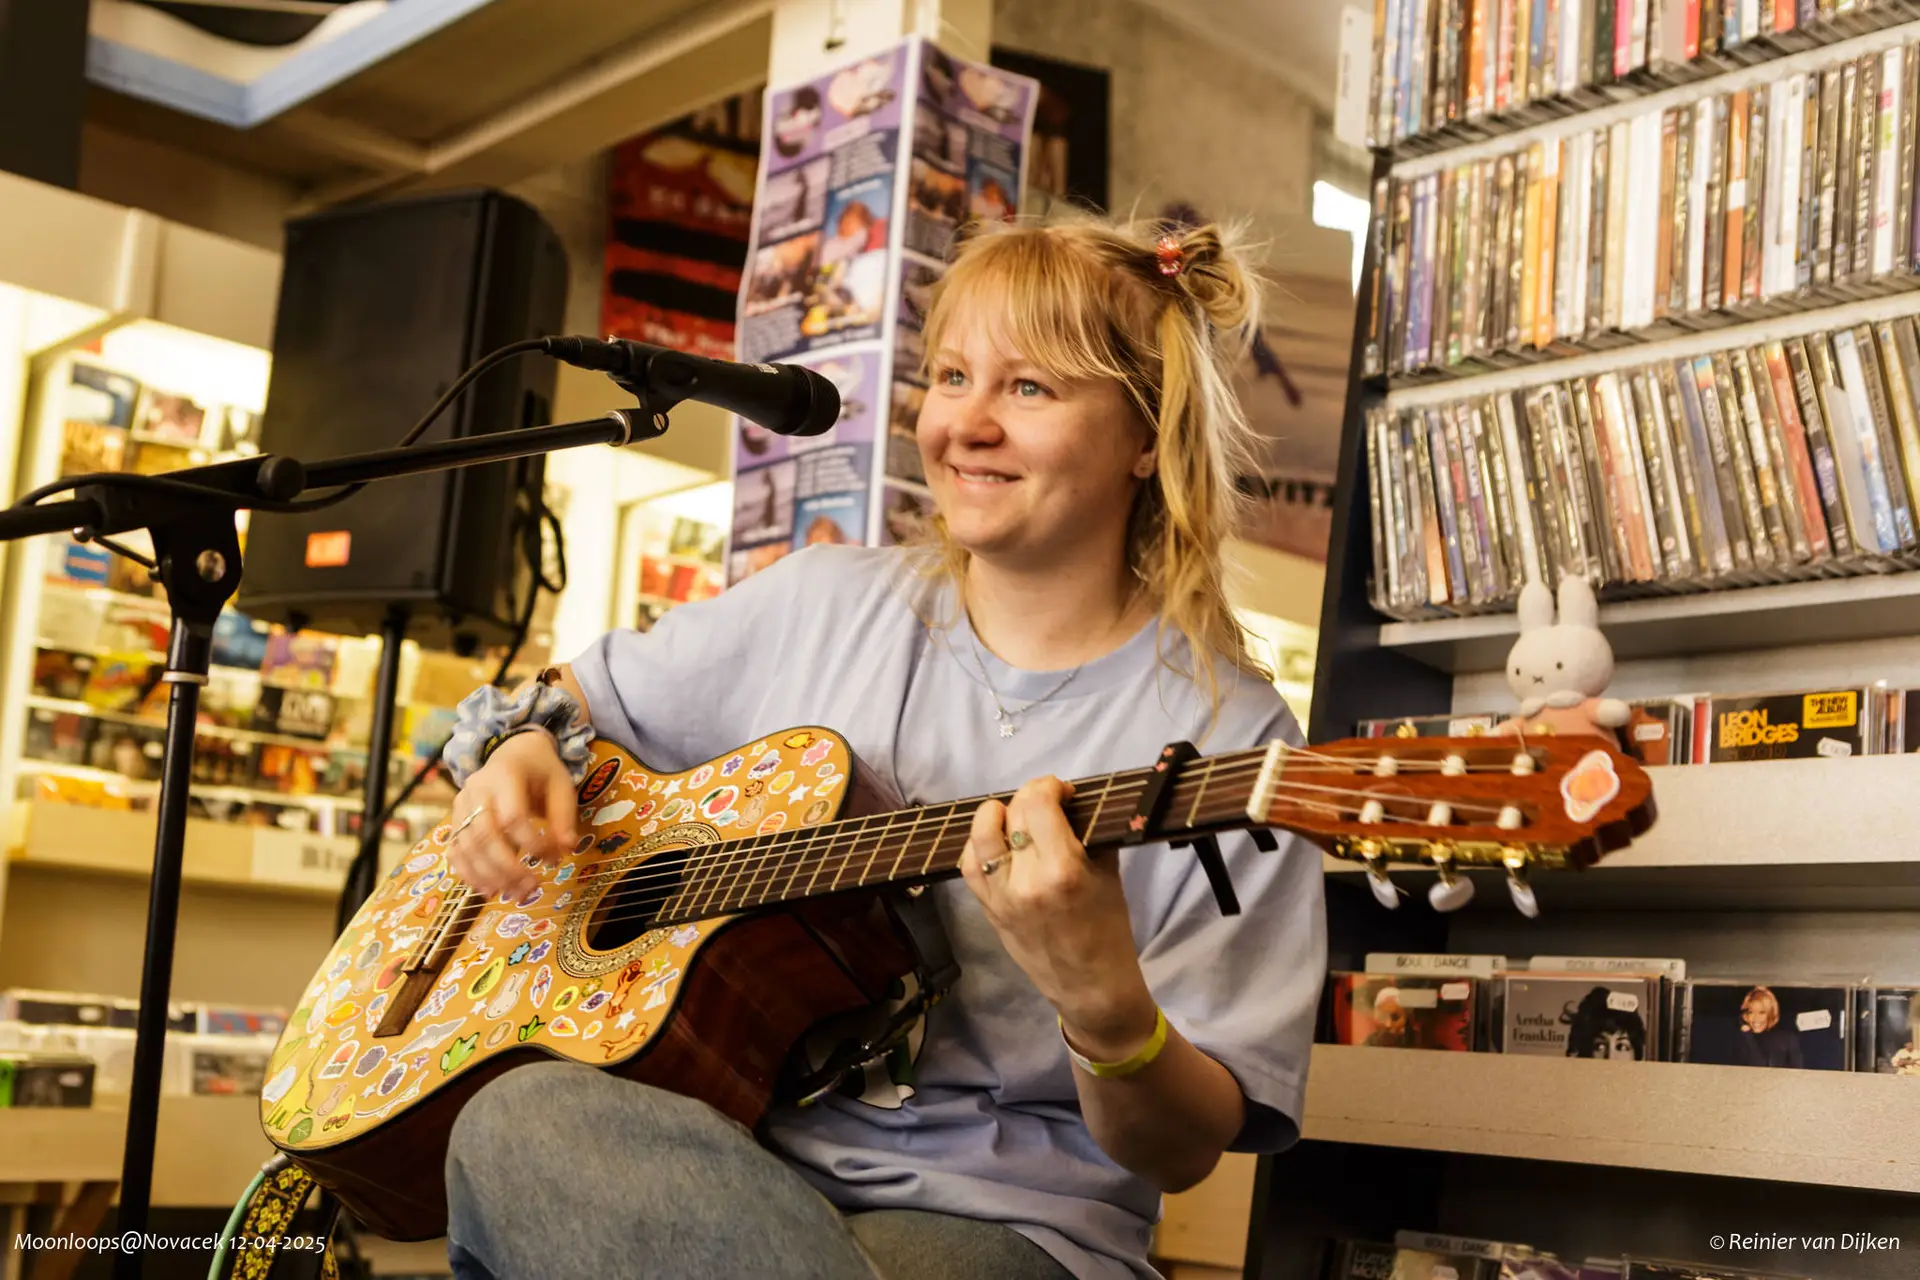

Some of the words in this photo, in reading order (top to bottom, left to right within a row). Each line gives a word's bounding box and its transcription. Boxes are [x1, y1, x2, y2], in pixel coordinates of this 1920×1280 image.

[1811, 697, 1826, 707] THE
[1827, 696, 1848, 705] NEW
[1816, 704, 1848, 714] ALBUM
[1719, 708, 1768, 731] LEON
[1719, 723, 1799, 748] BRIDGES
[1396, 956, 1423, 968] SOUL
[1433, 956, 1470, 968] DANCE
[1515, 1012, 1554, 1026] Aretha
[1513, 1028, 1565, 1042] Franklin
